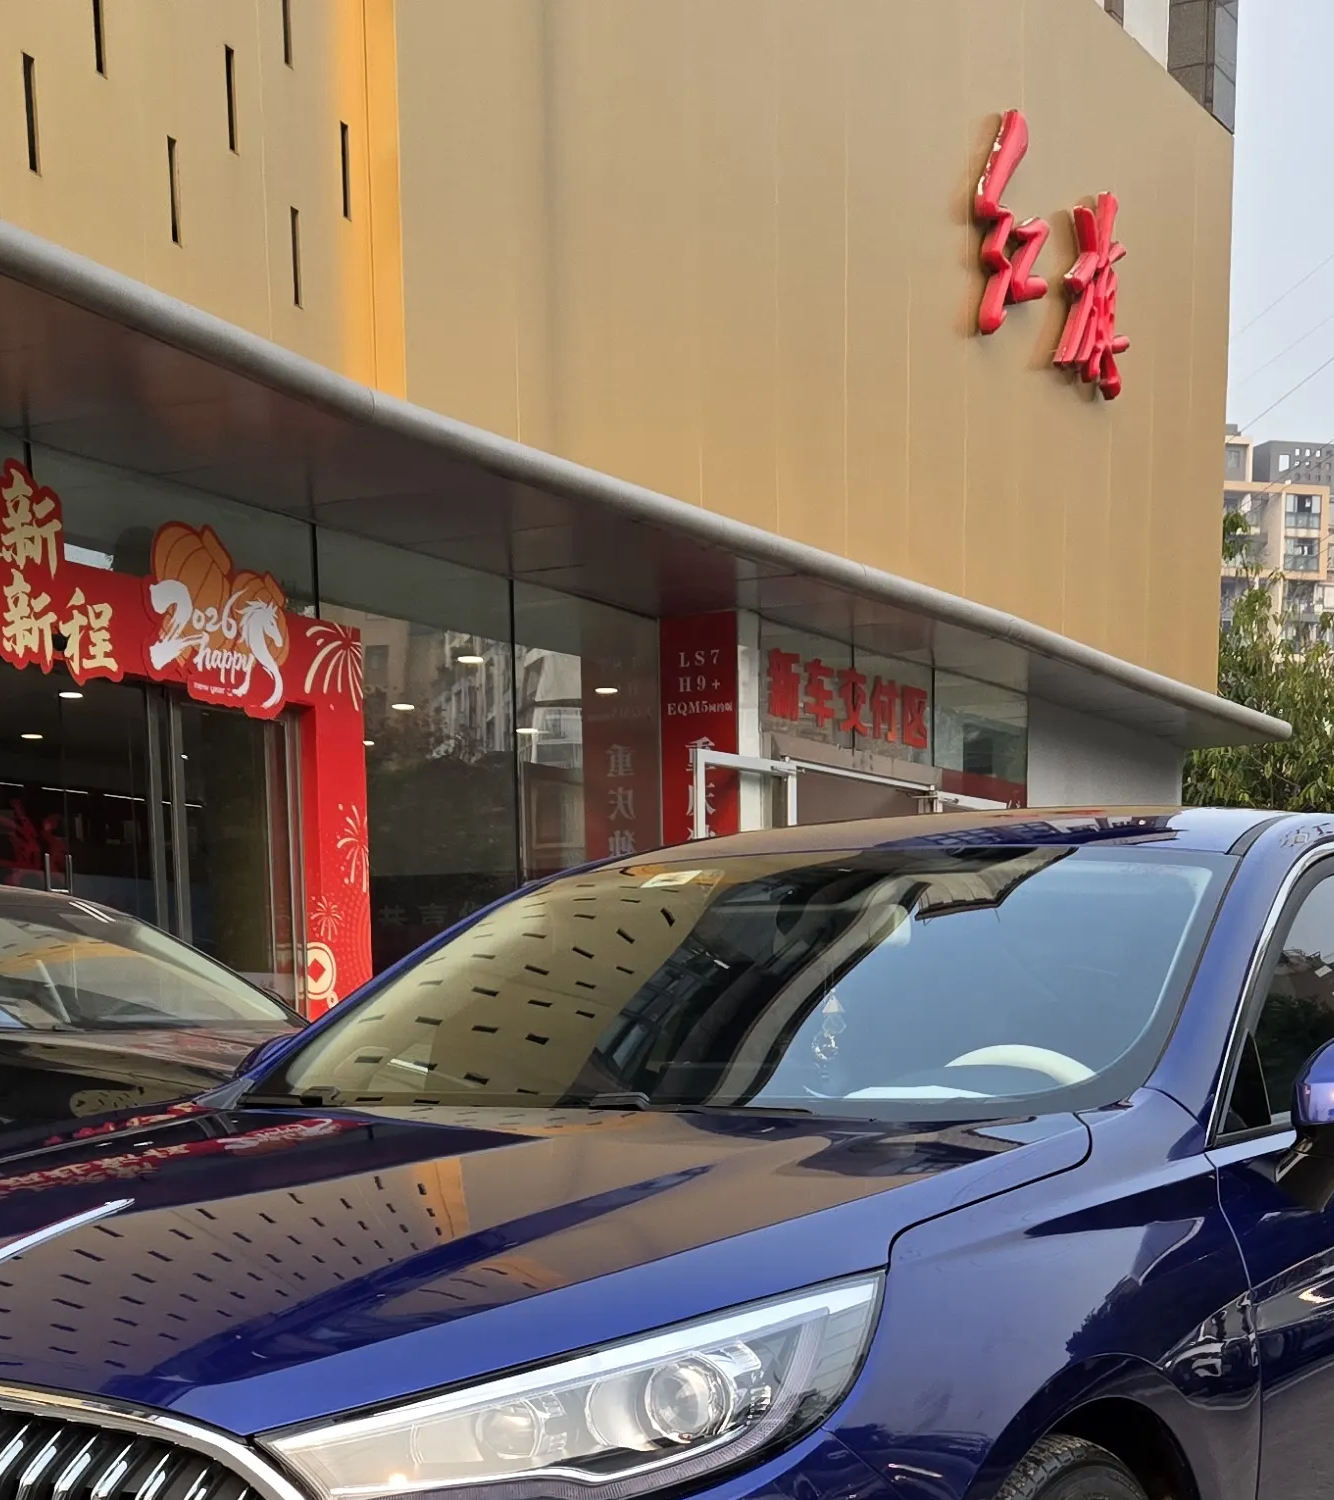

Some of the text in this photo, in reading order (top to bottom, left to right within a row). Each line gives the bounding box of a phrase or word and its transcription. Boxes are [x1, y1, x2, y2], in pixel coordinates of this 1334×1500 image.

[974, 108, 1130, 400] 红旗
[149, 578, 247, 671] 2026
[679, 649, 720, 668] LS7
[193, 640, 255, 695] happy
[678, 675, 721, 692] H9+
[768, 647, 928, 749] 新车交付区
